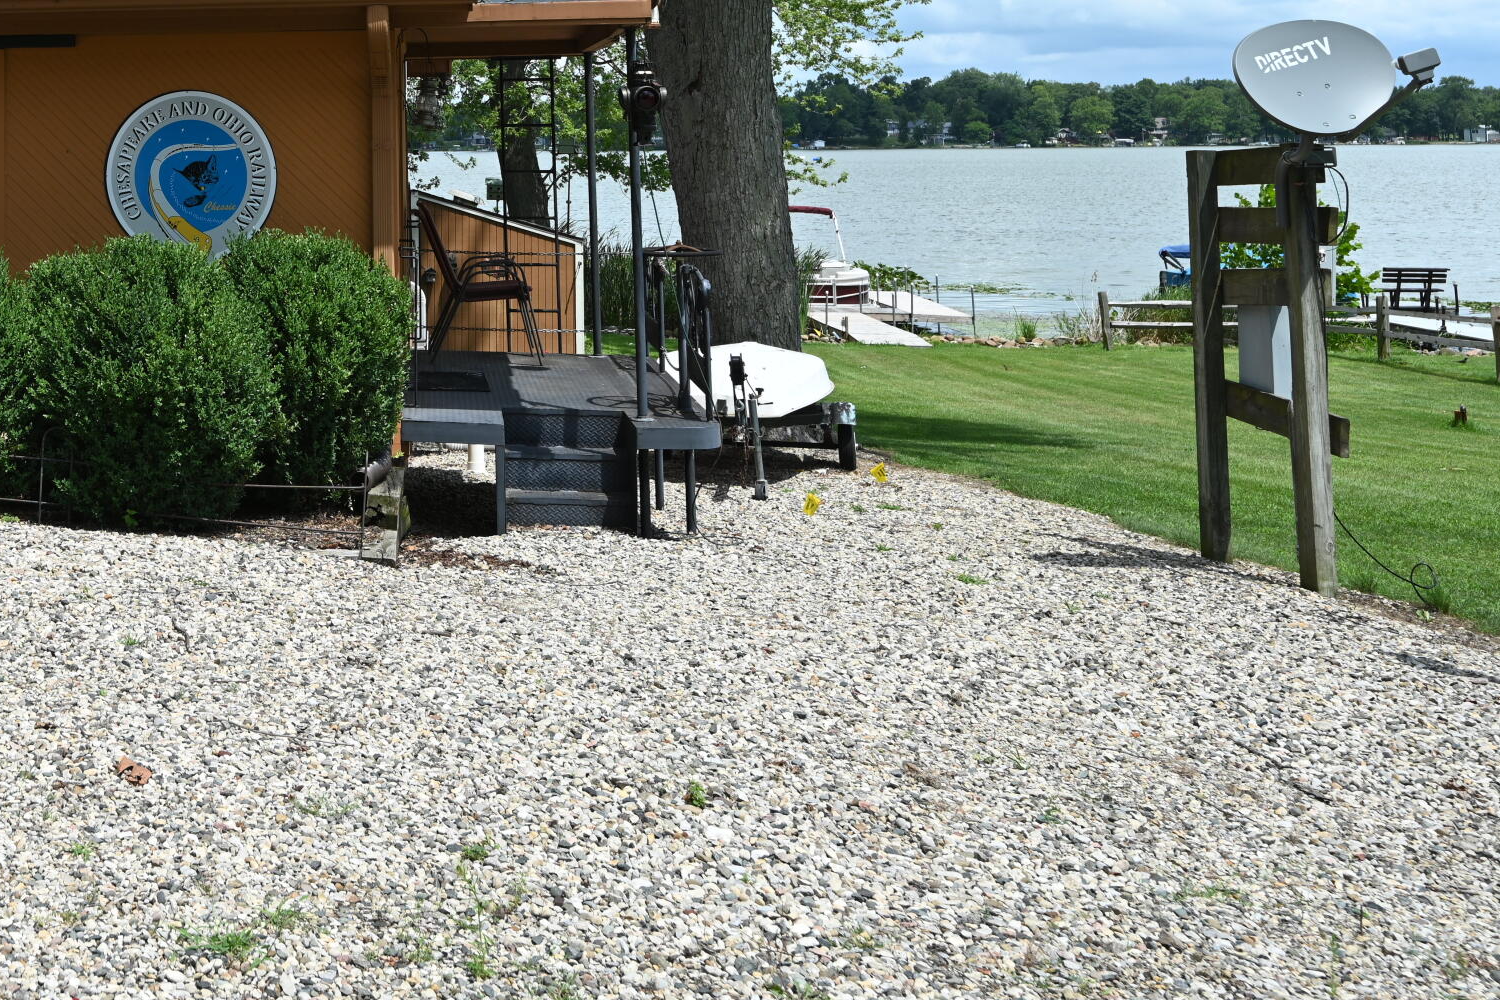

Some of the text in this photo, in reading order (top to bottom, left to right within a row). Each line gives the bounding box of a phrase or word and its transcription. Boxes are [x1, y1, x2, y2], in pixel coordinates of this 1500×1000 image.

[1254, 36, 1332, 74] DIRECTV
[116, 108, 167, 221] CHESAPEAKE
[168, 101, 210, 118] AND
[212, 107, 255, 147] OHIO
[234, 147, 266, 233] RAILWAY
